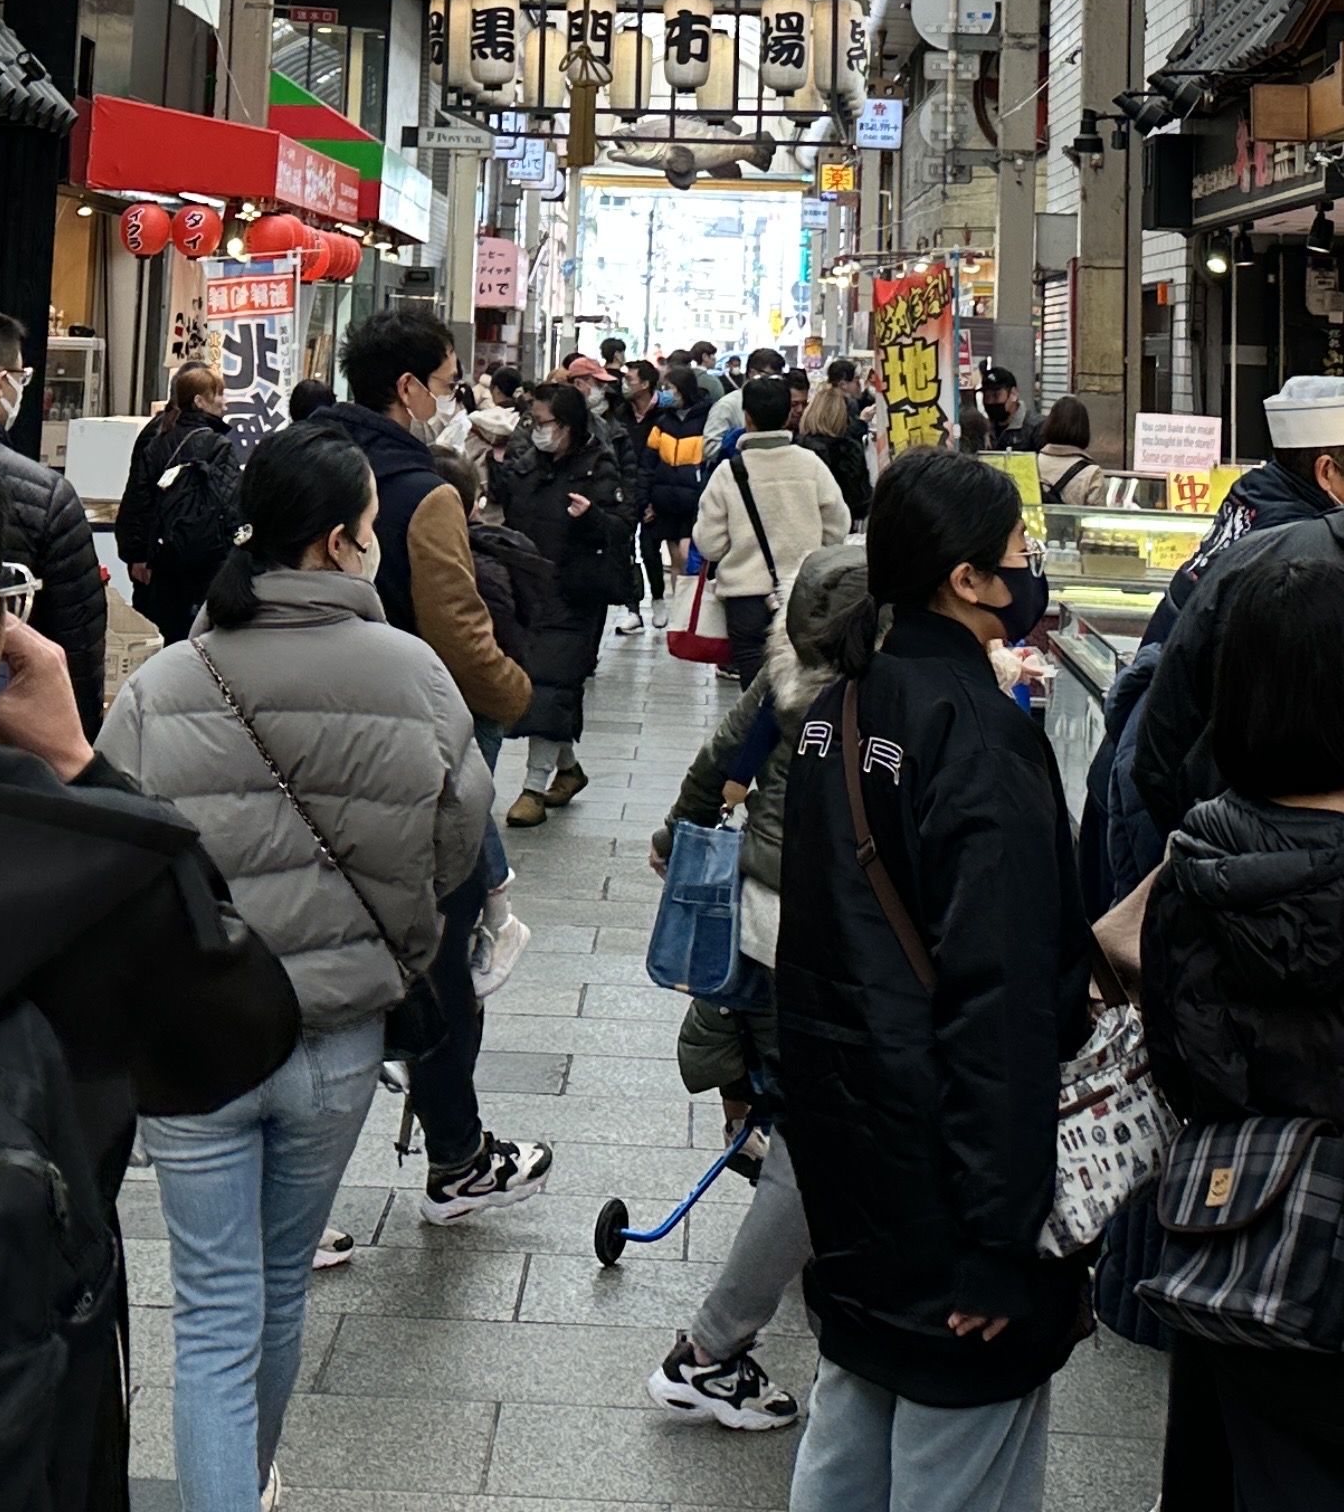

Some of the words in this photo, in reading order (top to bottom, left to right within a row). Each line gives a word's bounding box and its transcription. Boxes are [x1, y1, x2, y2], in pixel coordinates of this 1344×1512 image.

[471, 7, 805, 69] 黒門市場
[825, 167, 851, 190] 薬
[126, 209, 146, 251] イクラ
[186, 210, 205, 250] タイ
